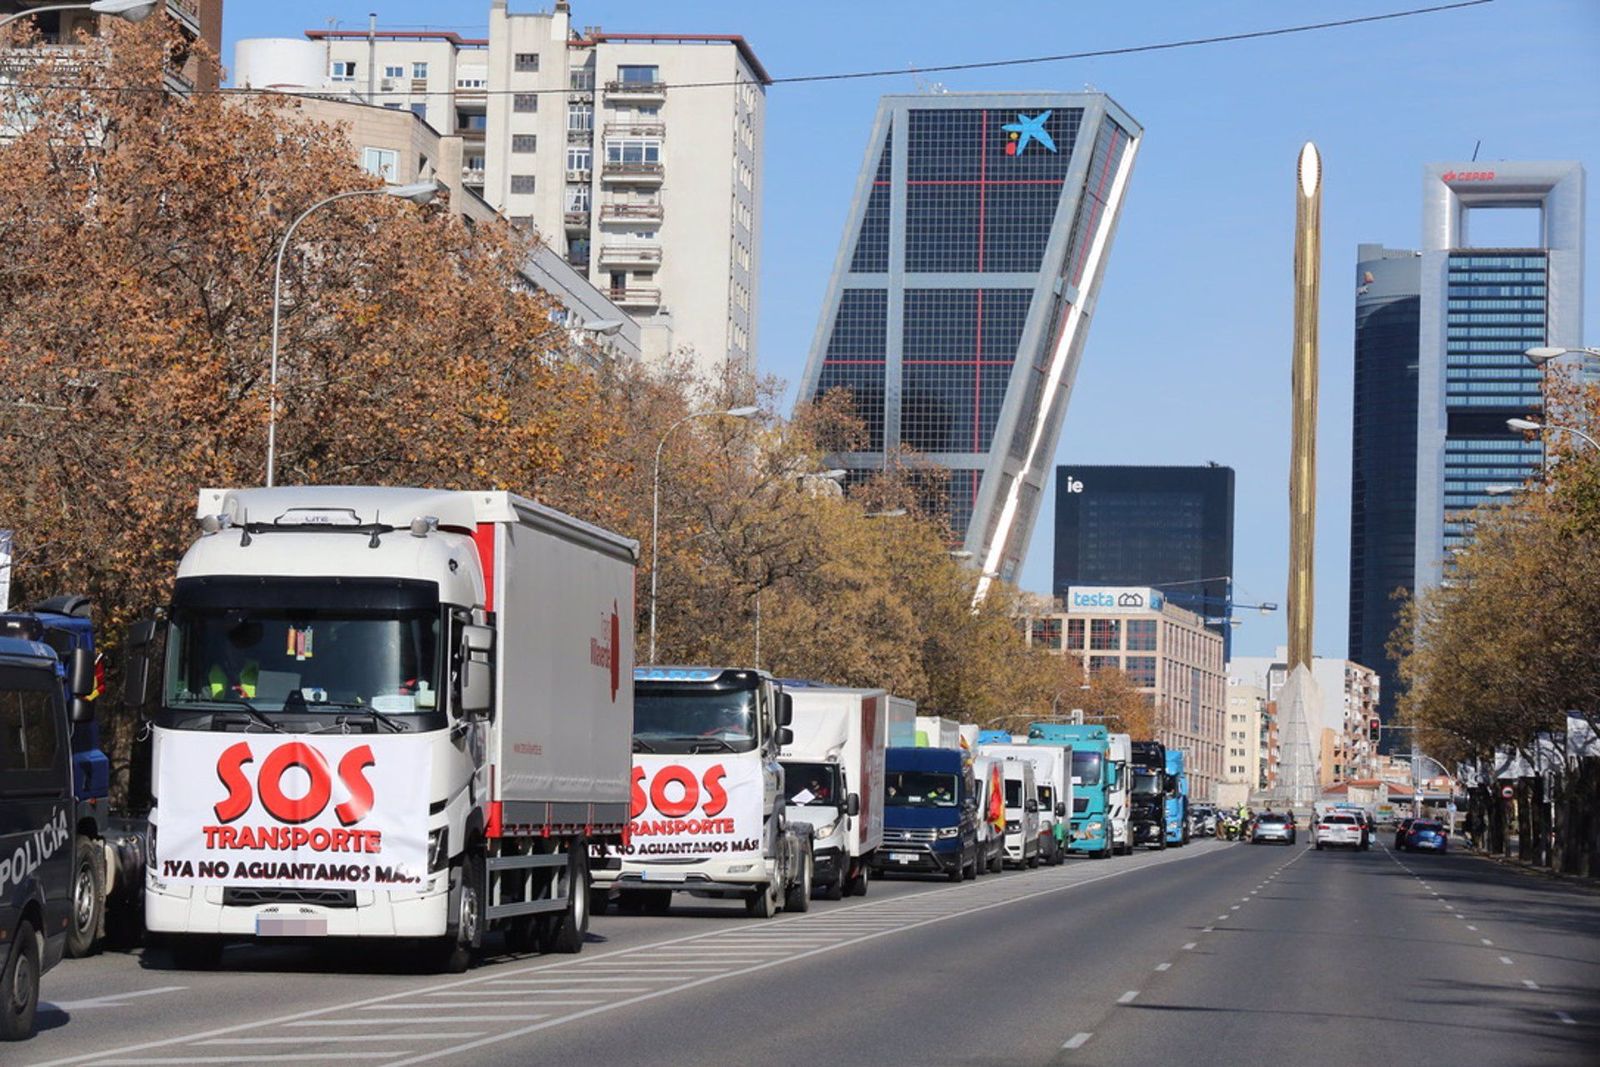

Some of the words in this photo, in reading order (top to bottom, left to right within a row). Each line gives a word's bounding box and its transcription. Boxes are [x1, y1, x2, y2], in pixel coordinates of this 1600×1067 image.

[1067, 476, 1084, 493] ie
[1073, 591, 1114, 607] testa
[213, 740, 376, 827] SOS
[629, 818, 735, 836] RANSPORTE
[203, 826, 381, 854] TRANSPORTE
[638, 841, 729, 855] AGUANTAMOS
[0, 805, 69, 897] POLICÍA
[162, 861, 194, 879] ¡YA
[199, 861, 230, 879] NO
[233, 862, 371, 883] AGUANTAMOS
